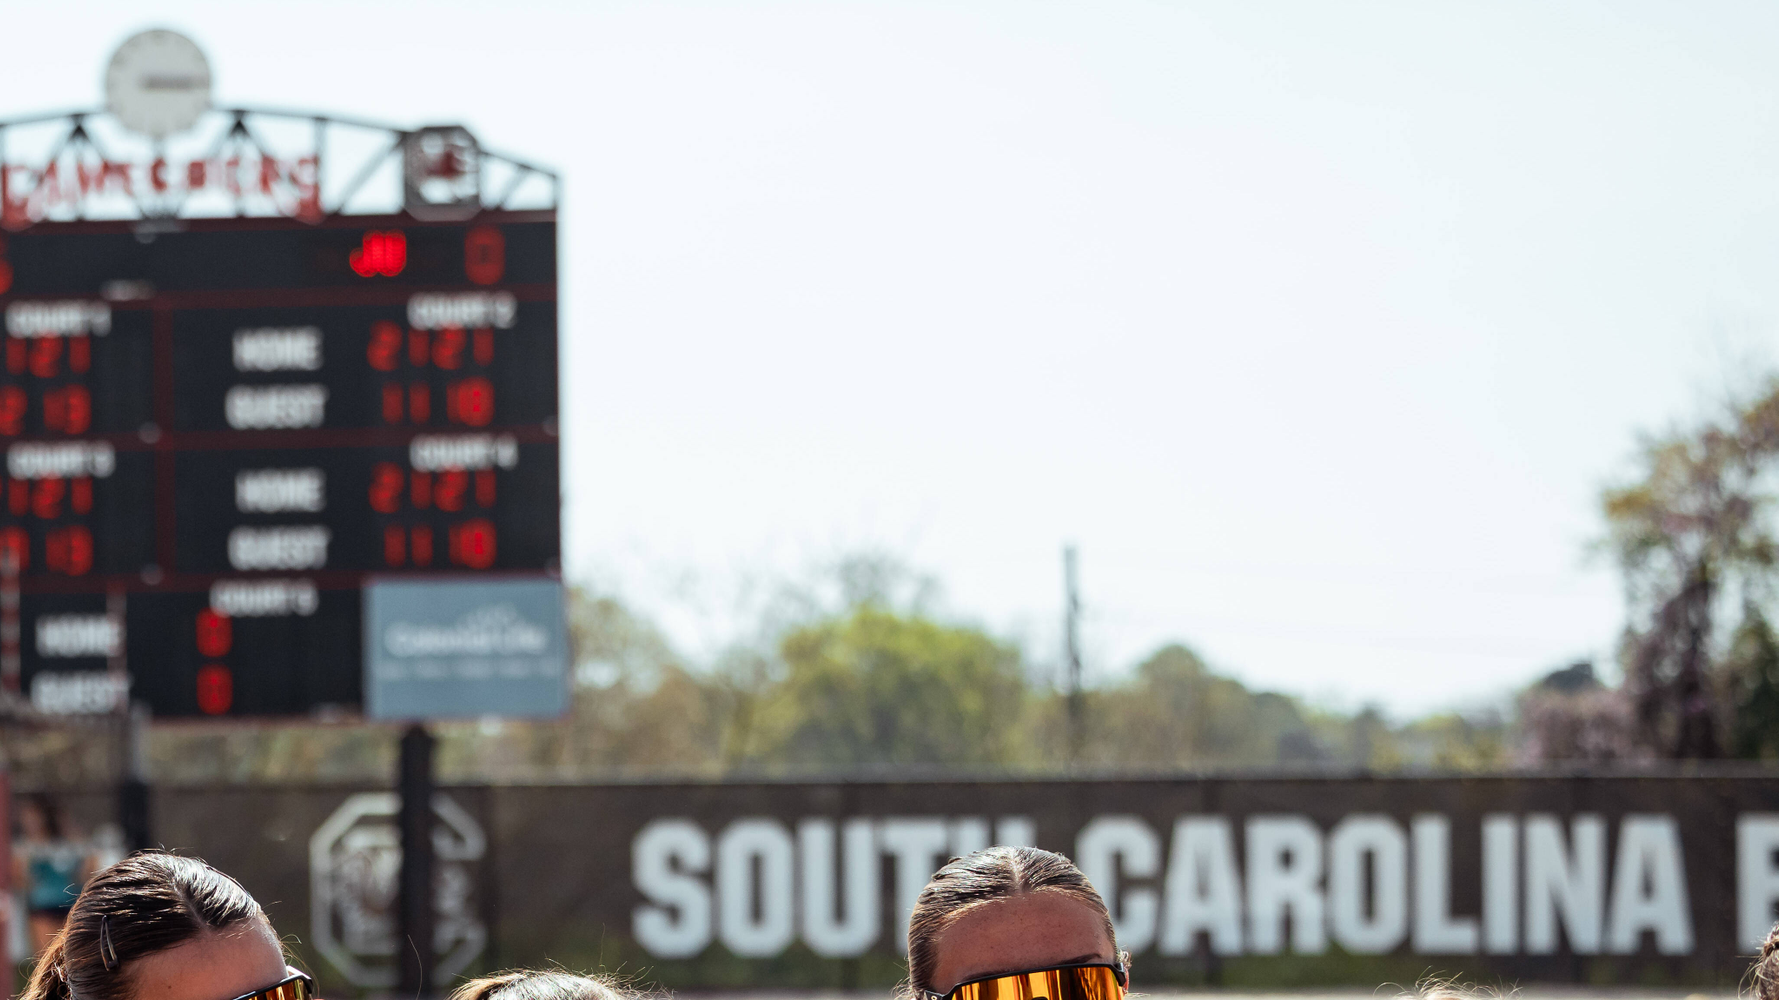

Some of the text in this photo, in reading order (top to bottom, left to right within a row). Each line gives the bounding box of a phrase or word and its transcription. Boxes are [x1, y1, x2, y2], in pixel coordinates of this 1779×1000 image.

[465, 226, 505, 285] 0
[6, 302, 88, 338] COURT
[407, 292, 490, 329] COURT
[233, 326, 323, 371] HOME
[225, 384, 329, 429] GUEST
[7, 441, 91, 479] COURT
[410, 432, 493, 472] COURT
[235, 468, 325, 513] HOME
[228, 525, 331, 570] GUEST
[209, 579, 293, 617] COURT
[36, 613, 123, 657] HOME
[30, 670, 133, 715] GUEST
[631, 816, 1038, 958] SOUT
[1075, 814, 1695, 956] CAROLINA
